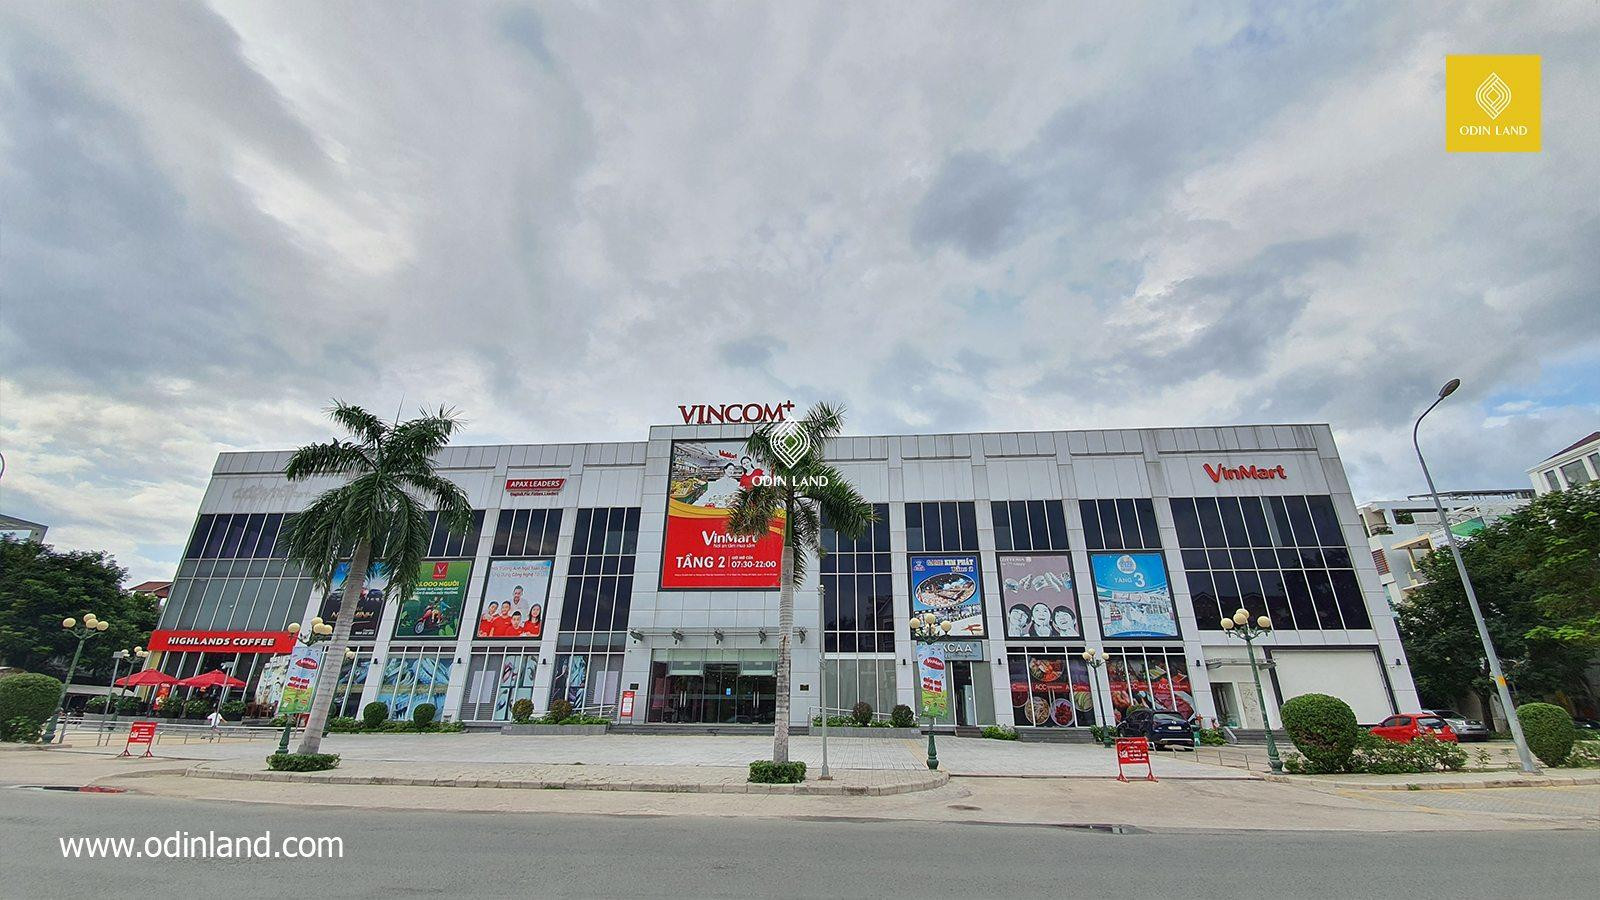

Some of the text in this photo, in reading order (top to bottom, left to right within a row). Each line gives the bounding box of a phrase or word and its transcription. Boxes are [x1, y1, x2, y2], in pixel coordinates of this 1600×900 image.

[1203, 463, 1288, 483] VinMart
[702, 530, 758, 546] VinMart
[676, 553, 725, 568] TẦNG 2
[731, 560, 777, 568] 07:30-22:00
[1133, 572, 1146, 588] 3
[168, 637, 275, 646] HIGHLANDS COFFEE
